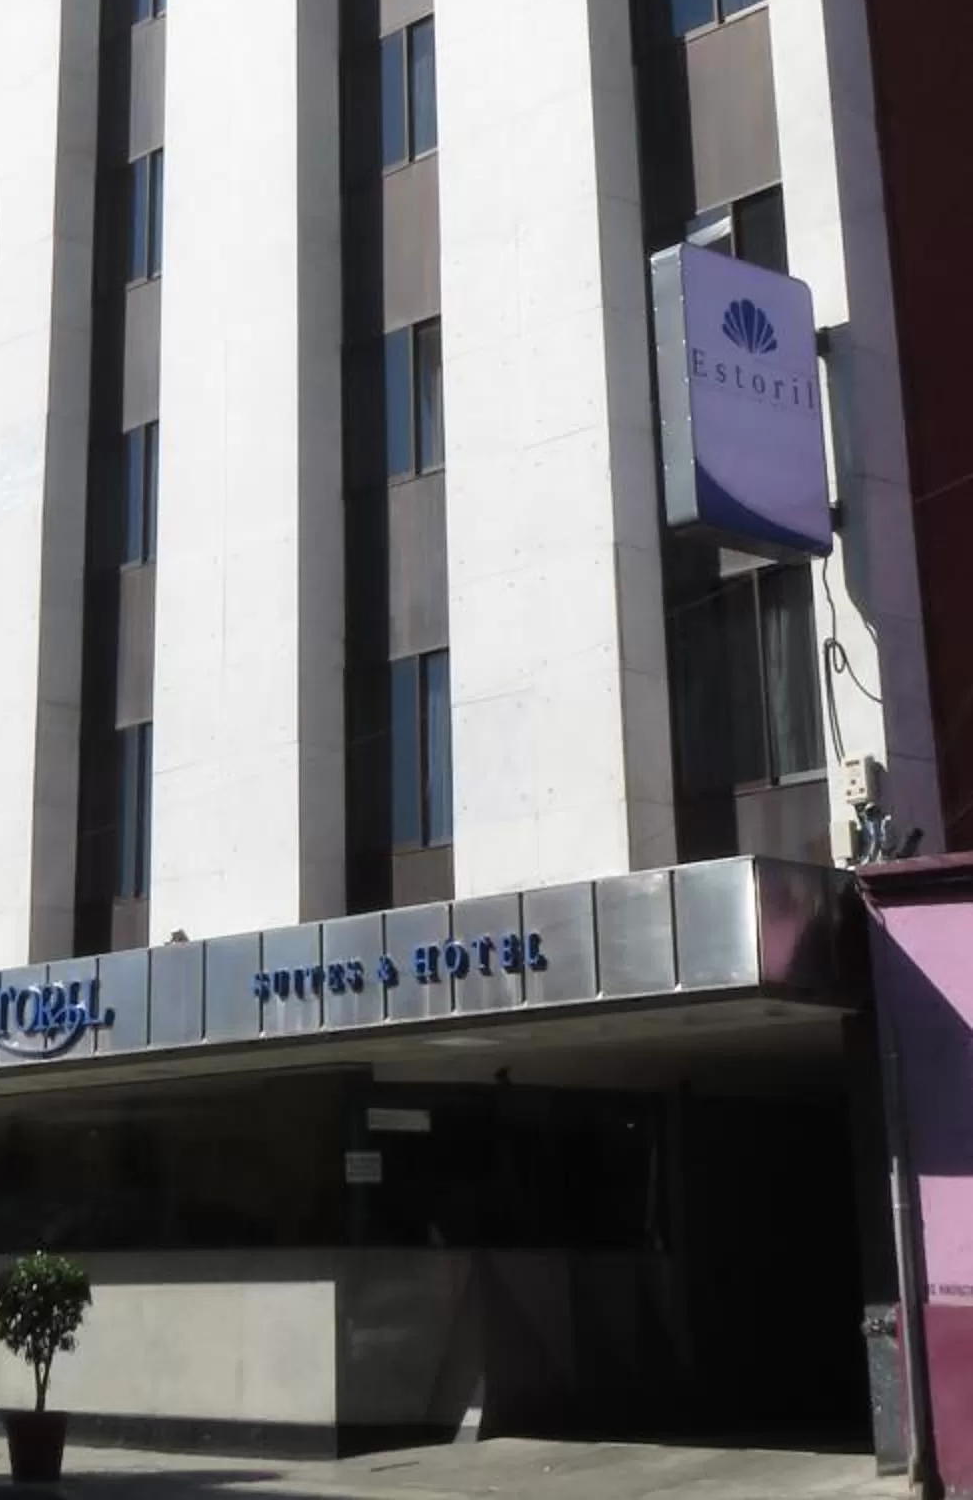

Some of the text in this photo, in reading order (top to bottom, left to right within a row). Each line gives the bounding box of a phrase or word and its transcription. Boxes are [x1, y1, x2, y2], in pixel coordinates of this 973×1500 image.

[692, 347, 816, 410] Estoril
[251, 955, 364, 1002] SUITES
[411, 931, 549, 985] HOTEL
